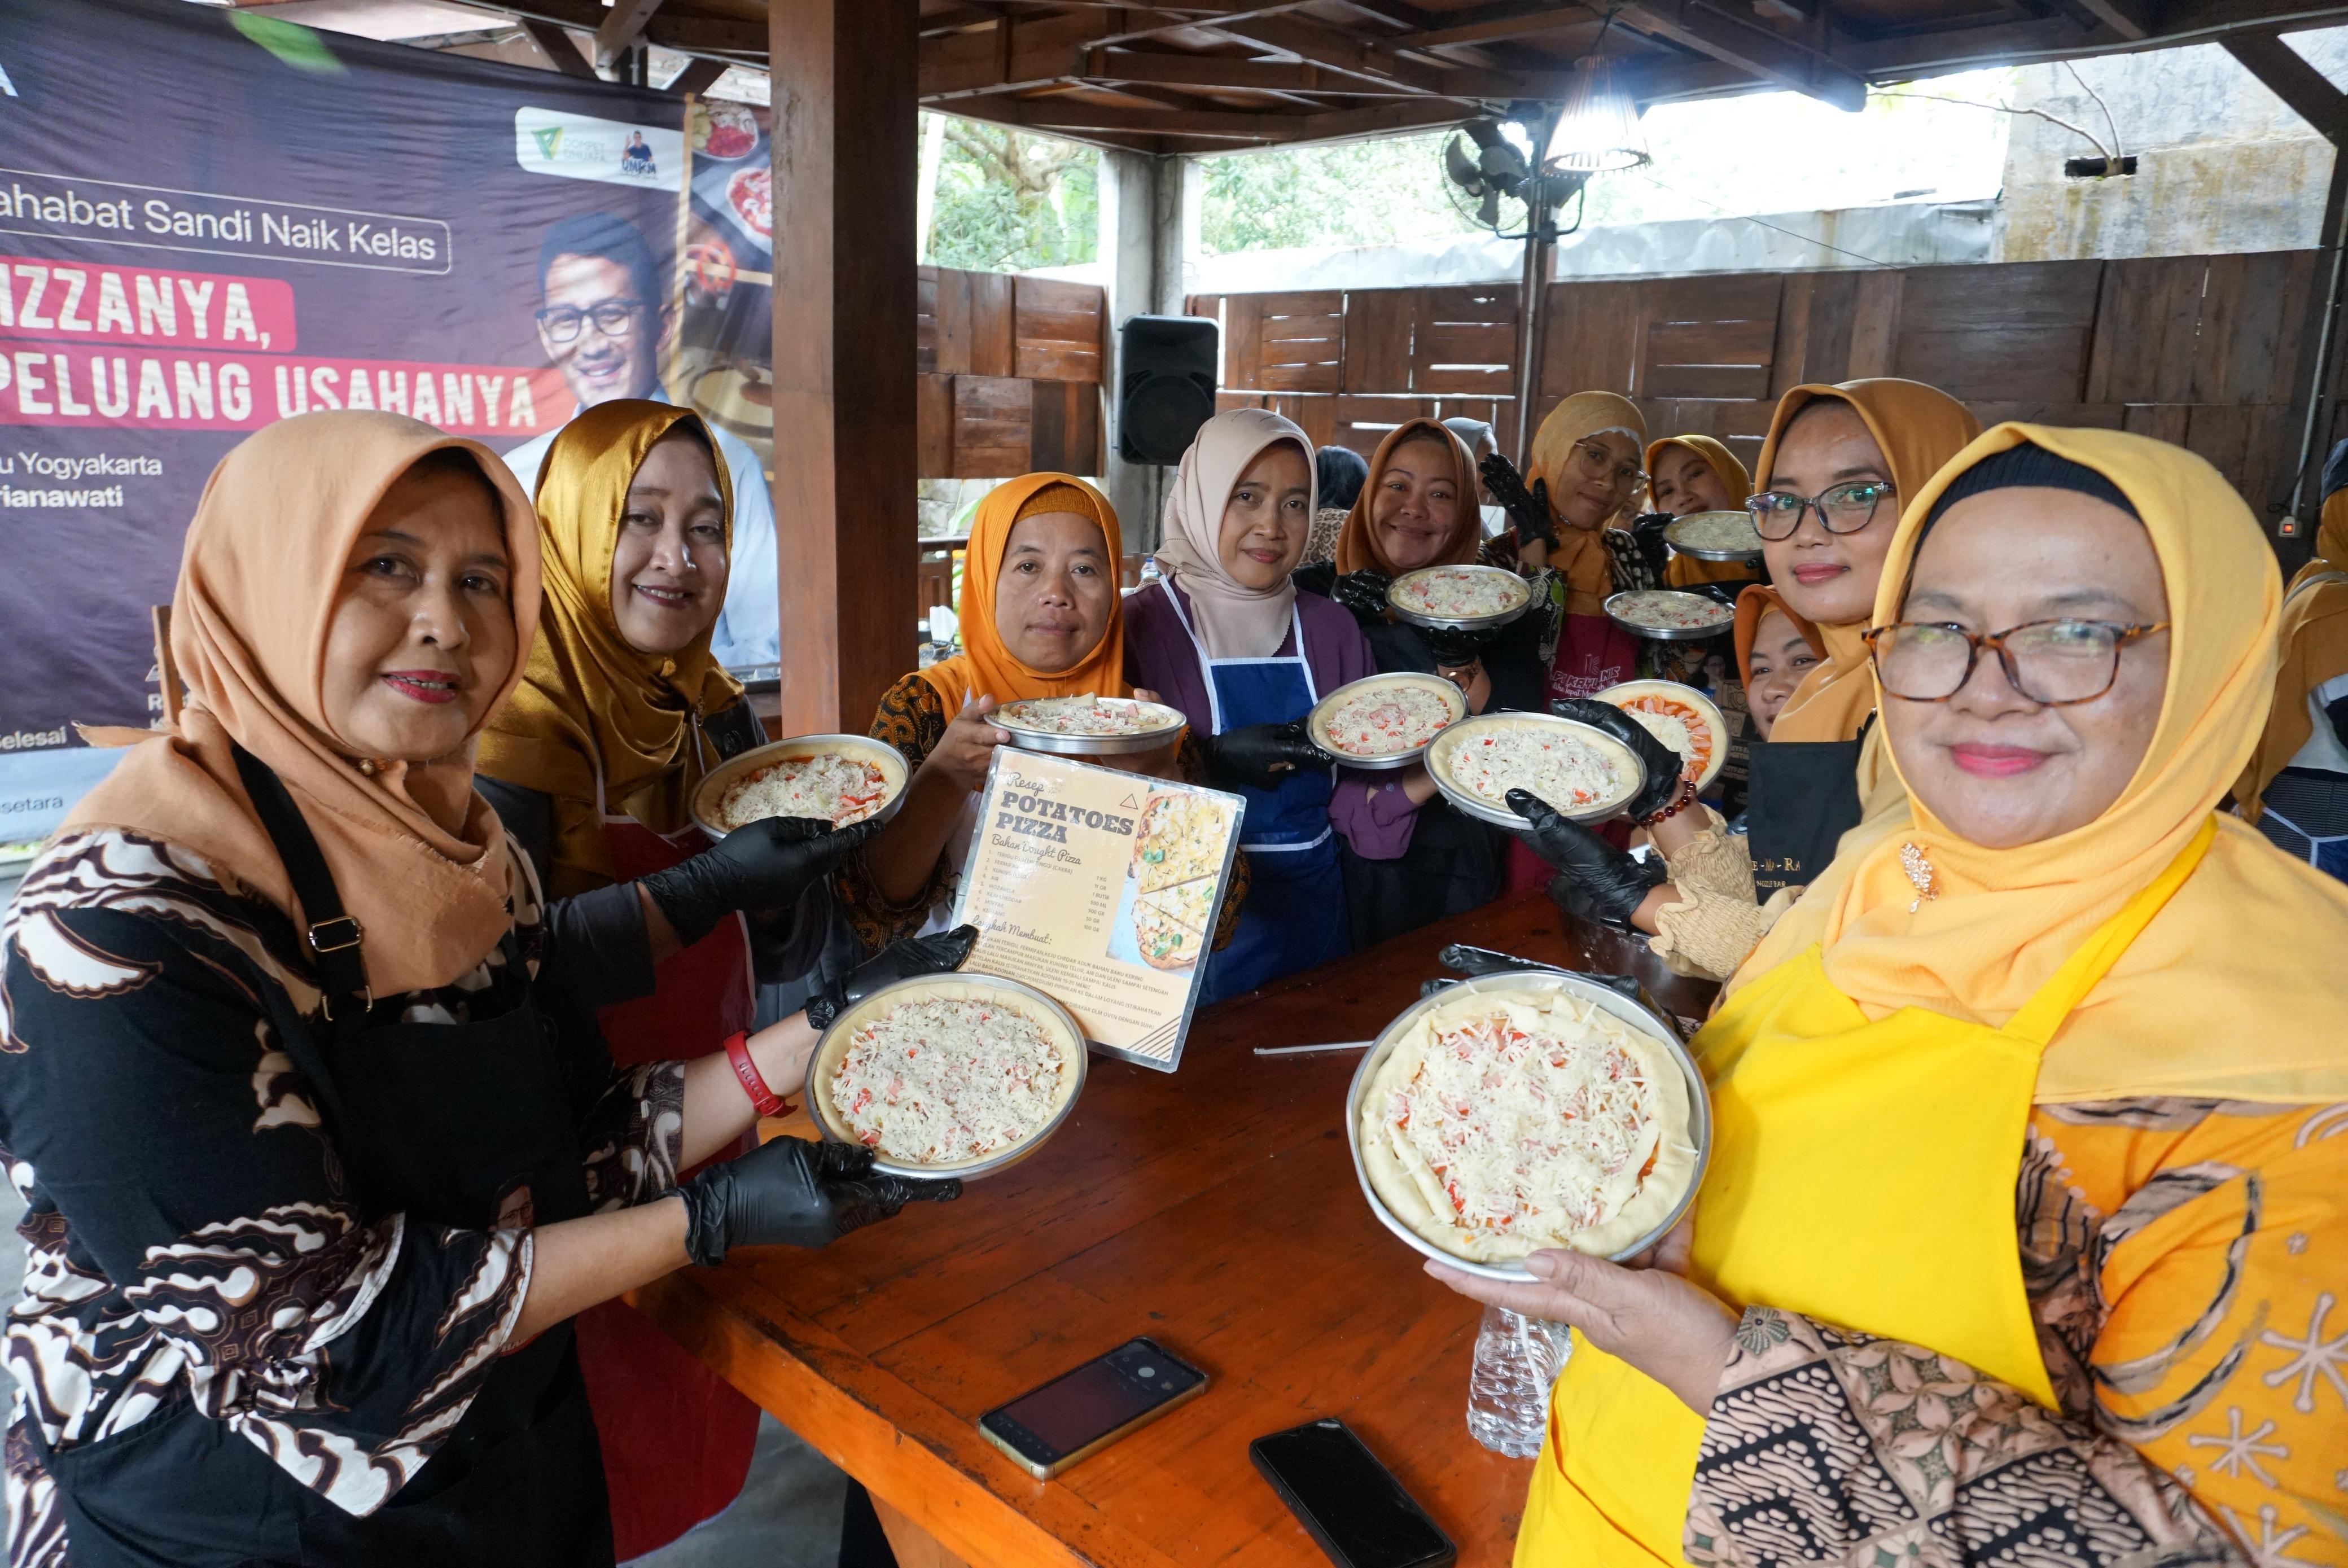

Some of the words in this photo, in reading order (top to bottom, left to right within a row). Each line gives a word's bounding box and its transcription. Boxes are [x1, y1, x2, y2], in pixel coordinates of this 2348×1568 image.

[144, 200, 252, 242] Sandi
[261, 212, 340, 252] Naik
[348, 222, 436, 260] Kelas
[275, 365, 536, 427] USAHANYA
[18, 452, 163, 480] Yogyakarta
[0, 726, 67, 750] elesai
[1007, 772, 1044, 796] Resep
[995, 812, 1068, 843] PIZZA
[1000, 791, 1134, 836] POTATOES
[991, 834, 1022, 849] Bahan
[1057, 849, 1083, 865] Pizza
[1052, 865, 1073, 874] (CAKRA)
[1009, 923, 1053, 944] Membuat:
[971, 953, 991, 962] SETELAH
[1040, 973, 1062, 982] ADONAN
[975, 940, 994, 949] SEELAH
[995, 945, 1024, 957] TERCAMPUR
[1024, 953, 1049, 963] MASUKAN
[1049, 960, 1068, 969] KUNING
[1122, 979, 1141, 988] SAMPAI
[1142, 985, 1168, 996] SETENGAH
[977, 934, 1000, 943] AUKAN
[1057, 954, 1076, 963] CHEDAR
[1092, 963, 1110, 973] BAHAN
[1124, 973, 1143, 982] KERING
[999, 954, 1023, 963] MASUKAN
[1059, 970, 1081, 980] KEMBALI
[1081, 976, 1101, 985] SAMPAI
[993, 967, 1015, 976] ADONAN
[1084, 991, 1103, 1000] DALAM
[1103, 996, 1124, 1006] LOYANG
[1125, 1002, 1162, 1016] ISTIRAHATKAN
[1118, 1015, 1140, 1026] DENGAN
